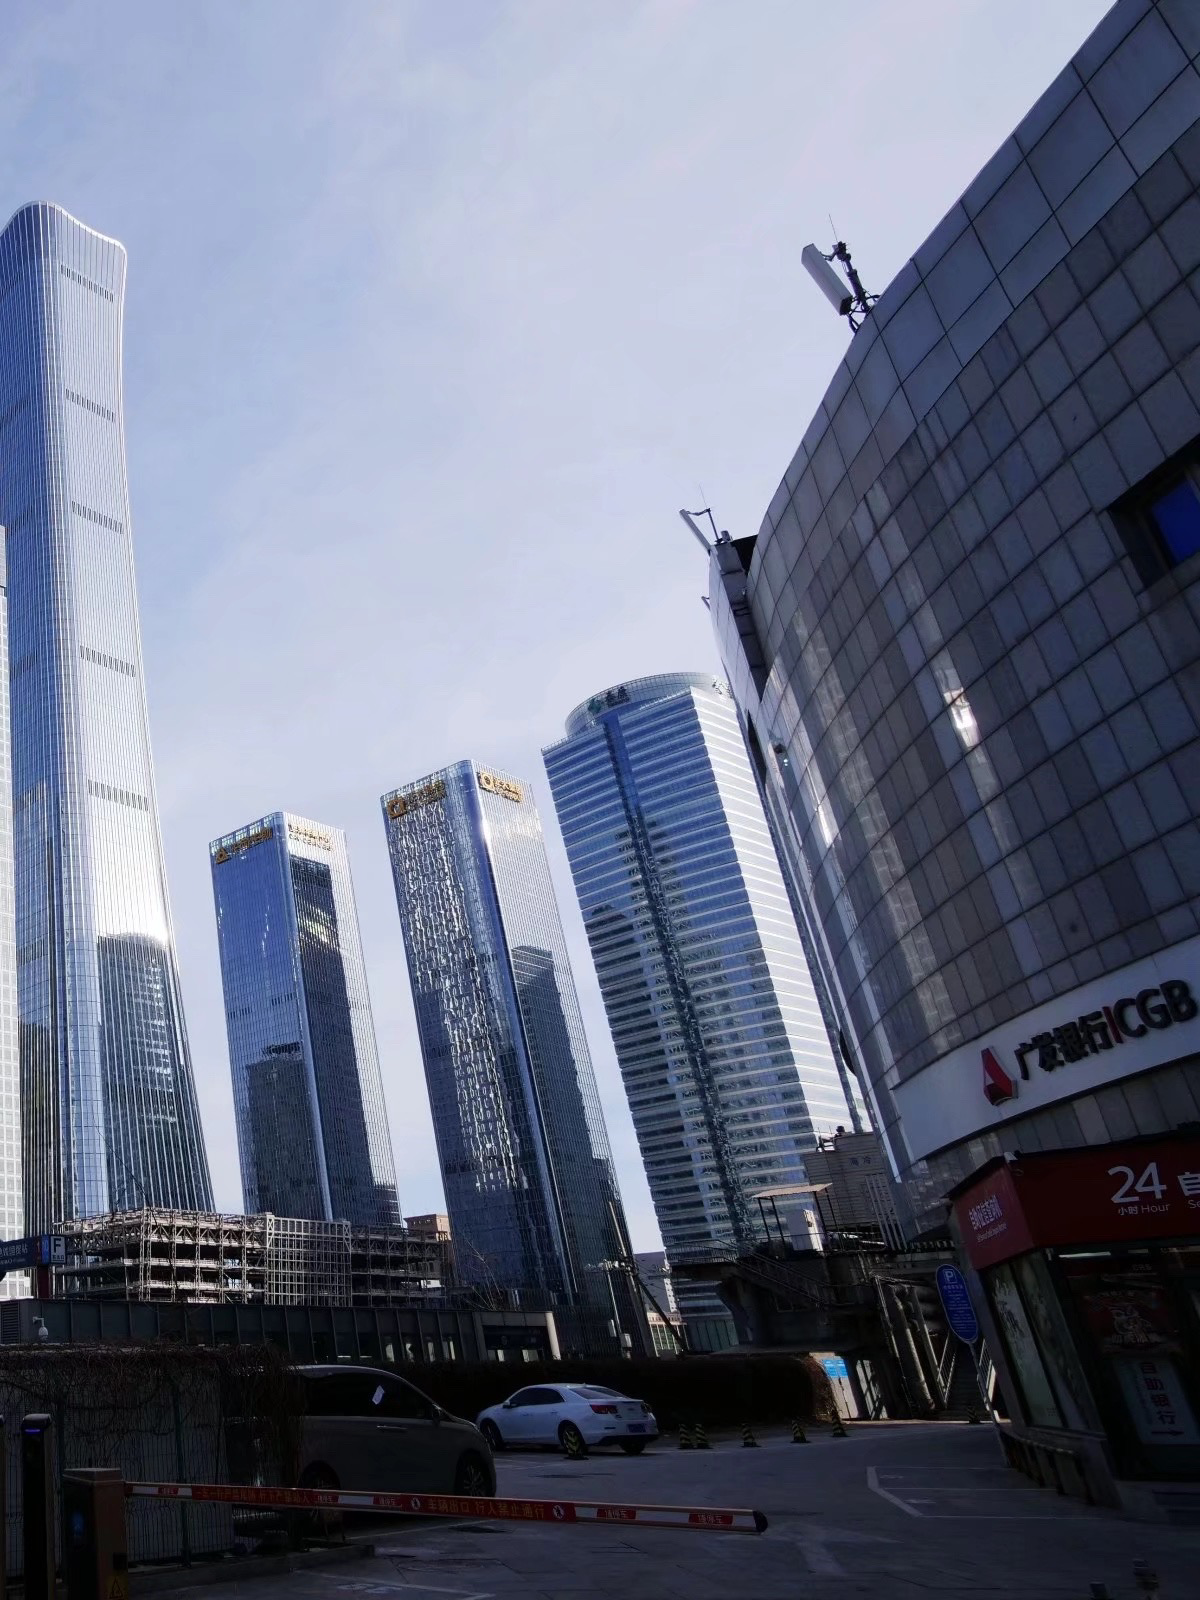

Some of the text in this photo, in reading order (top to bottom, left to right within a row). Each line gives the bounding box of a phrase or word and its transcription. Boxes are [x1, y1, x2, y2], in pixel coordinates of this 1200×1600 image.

[1014, 979, 1198, 1080] 广发银行 CGB
[1107, 1161, 1168, 1204] 24
[1140, 1203, 1171, 1214] Hour
[53, 1237, 62, 1253] F
[1140, 1361, 1177, 1425] 自助银行
[428, 1497, 545, 1520] 车辆出口 行人禁止通行
